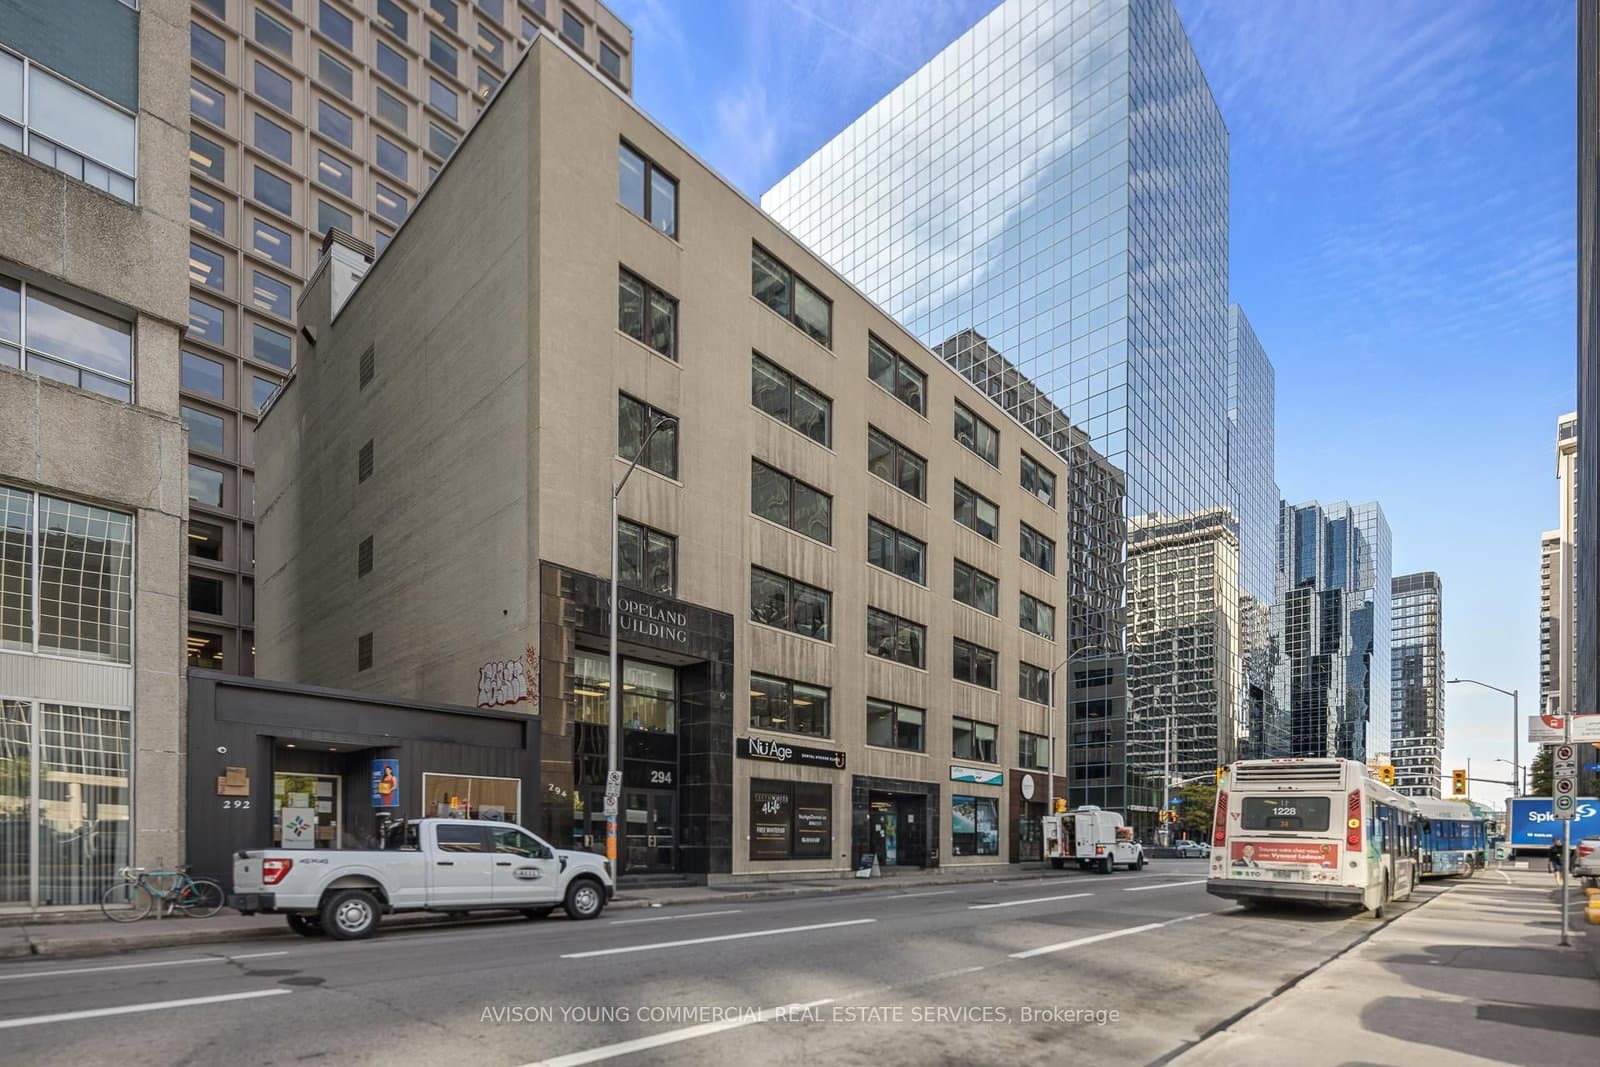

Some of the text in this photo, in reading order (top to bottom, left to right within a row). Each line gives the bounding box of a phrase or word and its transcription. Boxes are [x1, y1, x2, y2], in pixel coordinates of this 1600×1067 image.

[608, 612, 687, 643] UILDING
[650, 770, 672, 784] 294
[548, 783, 567, 798] 294
[223, 800, 251, 809] 292
[1272, 807, 1297, 816] 1228
